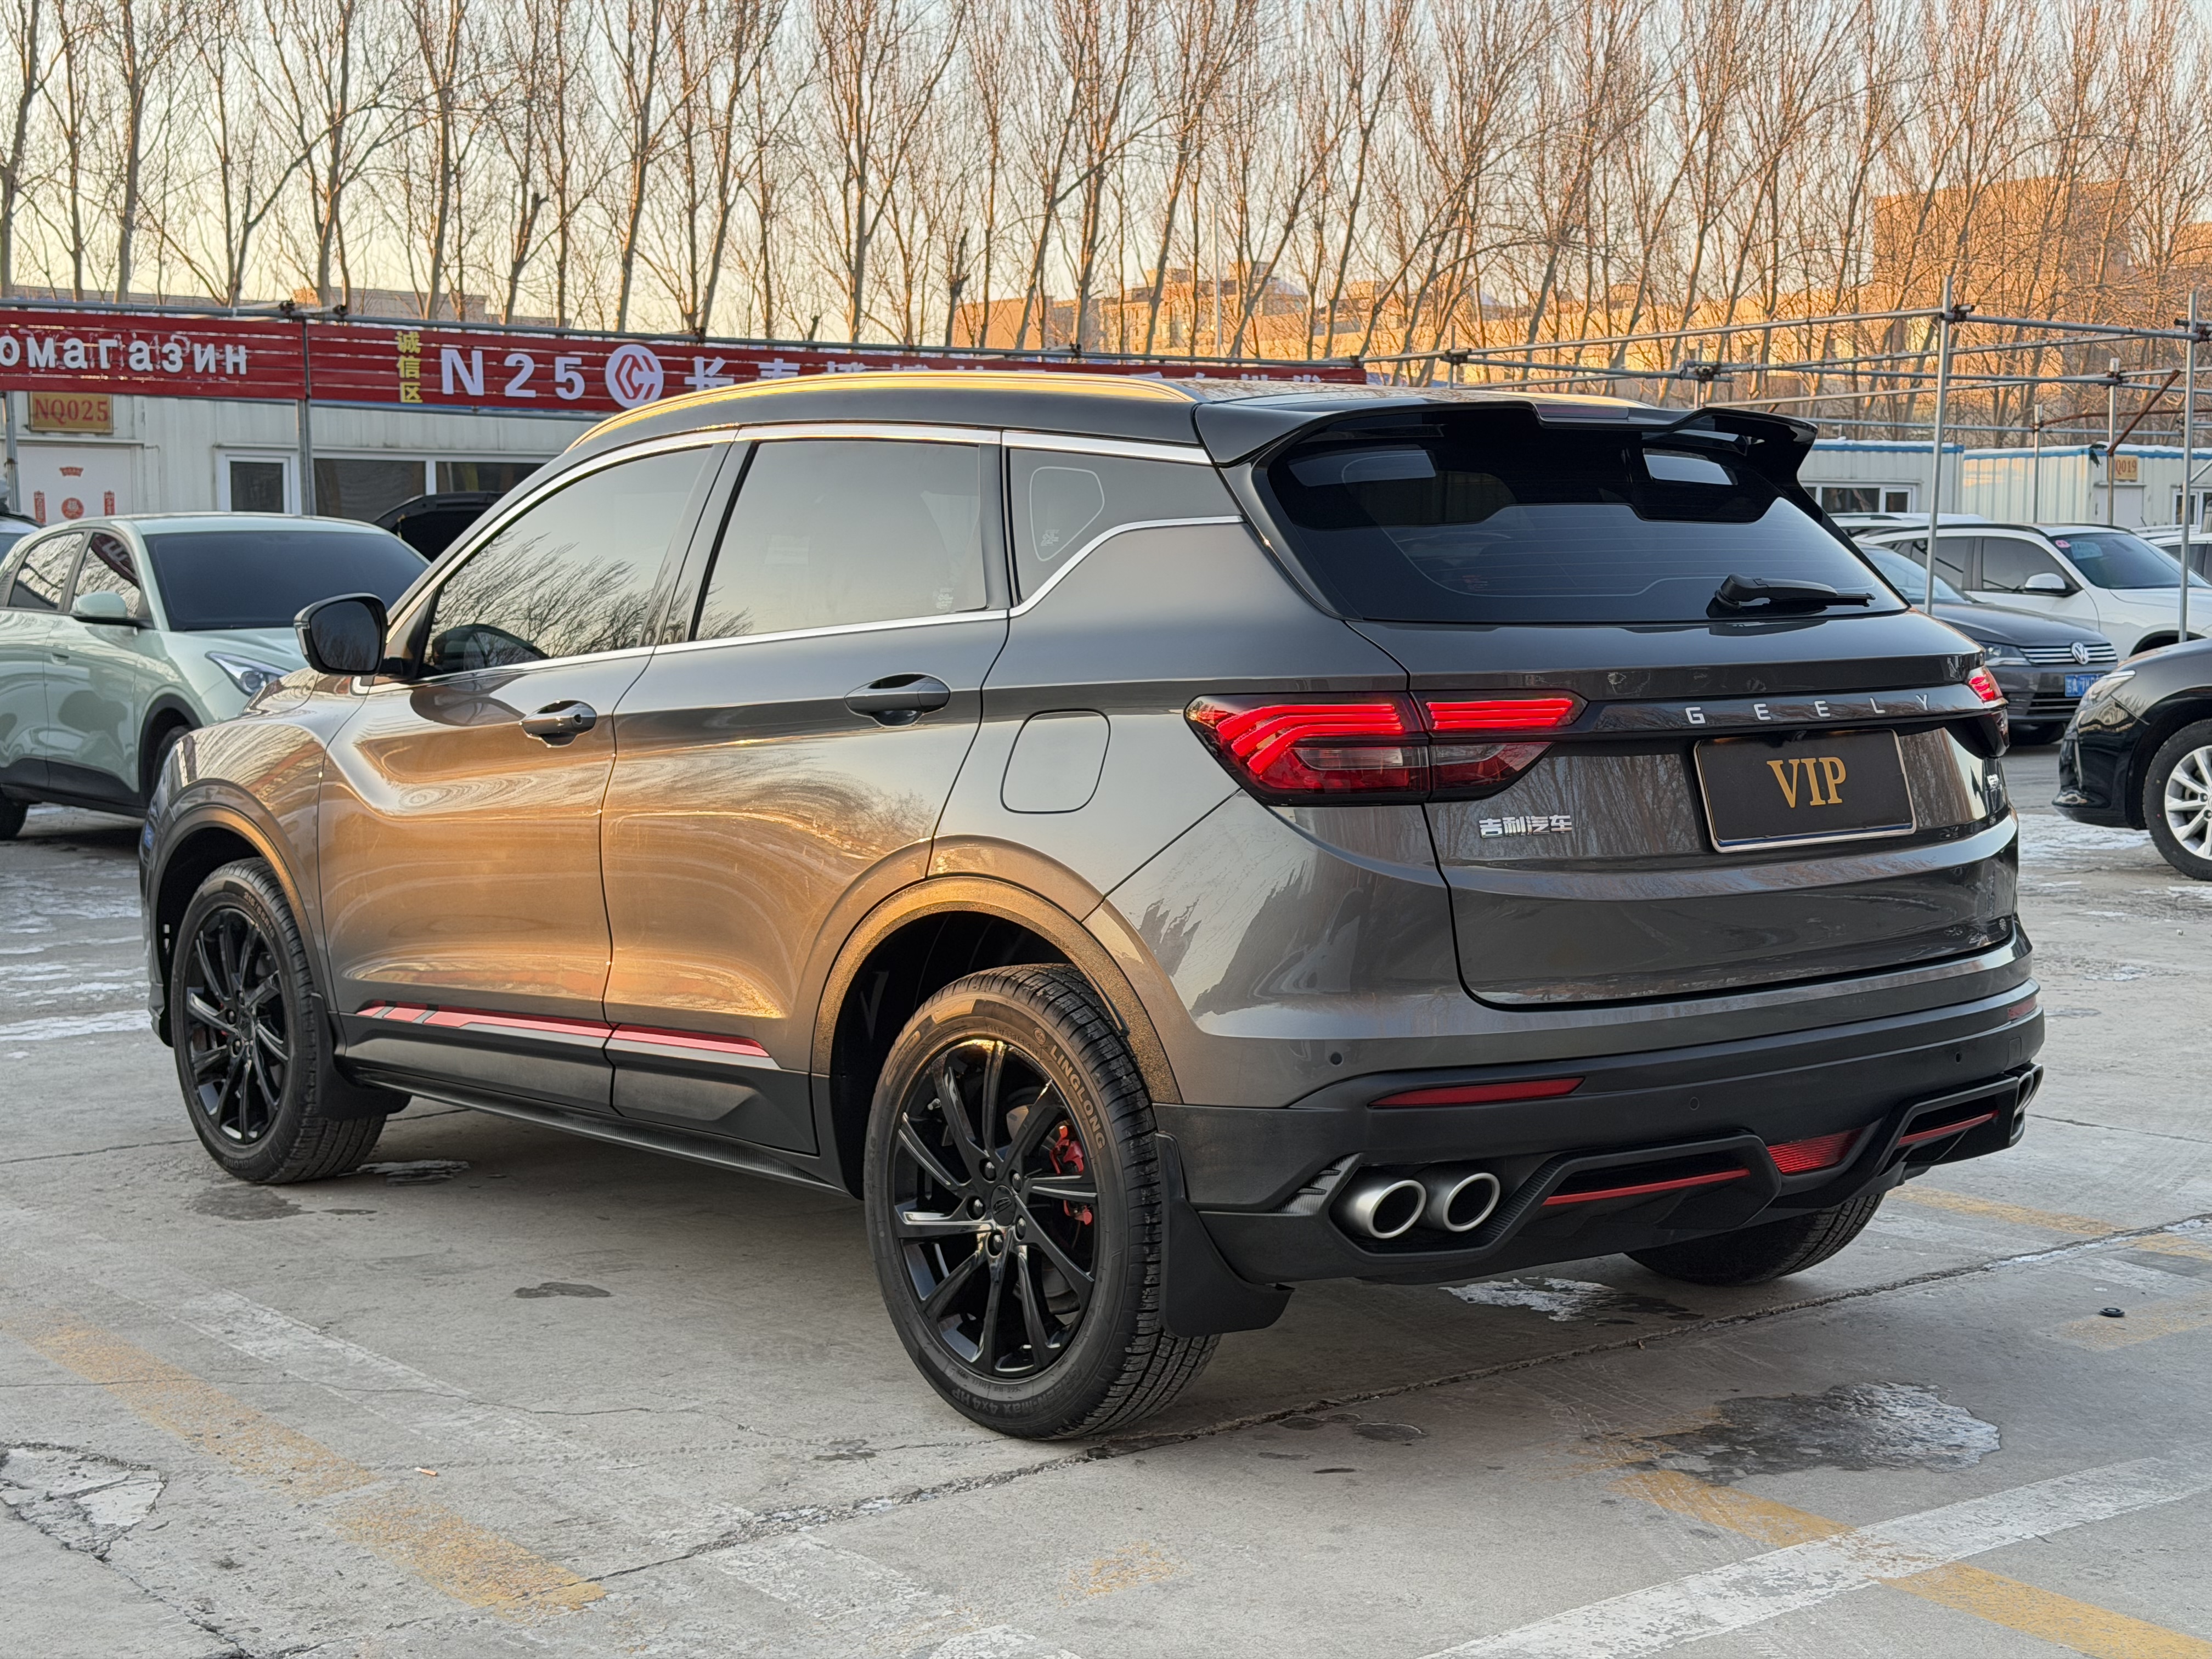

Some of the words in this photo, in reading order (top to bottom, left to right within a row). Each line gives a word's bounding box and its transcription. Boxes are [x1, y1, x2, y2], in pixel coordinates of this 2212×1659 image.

[0, 335, 247, 375] омагазин
[395, 331, 422, 403] 诚信区
[35, 398, 108, 426] NQ025
[1685, 694, 1929, 724] GEELY
[1767, 757, 1846, 808] VIP
[1479, 814, 1572, 838] 吉利汽车
[1050, 1045, 1106, 1150] LINGLONG
[951, 1388, 970, 1405] HP
